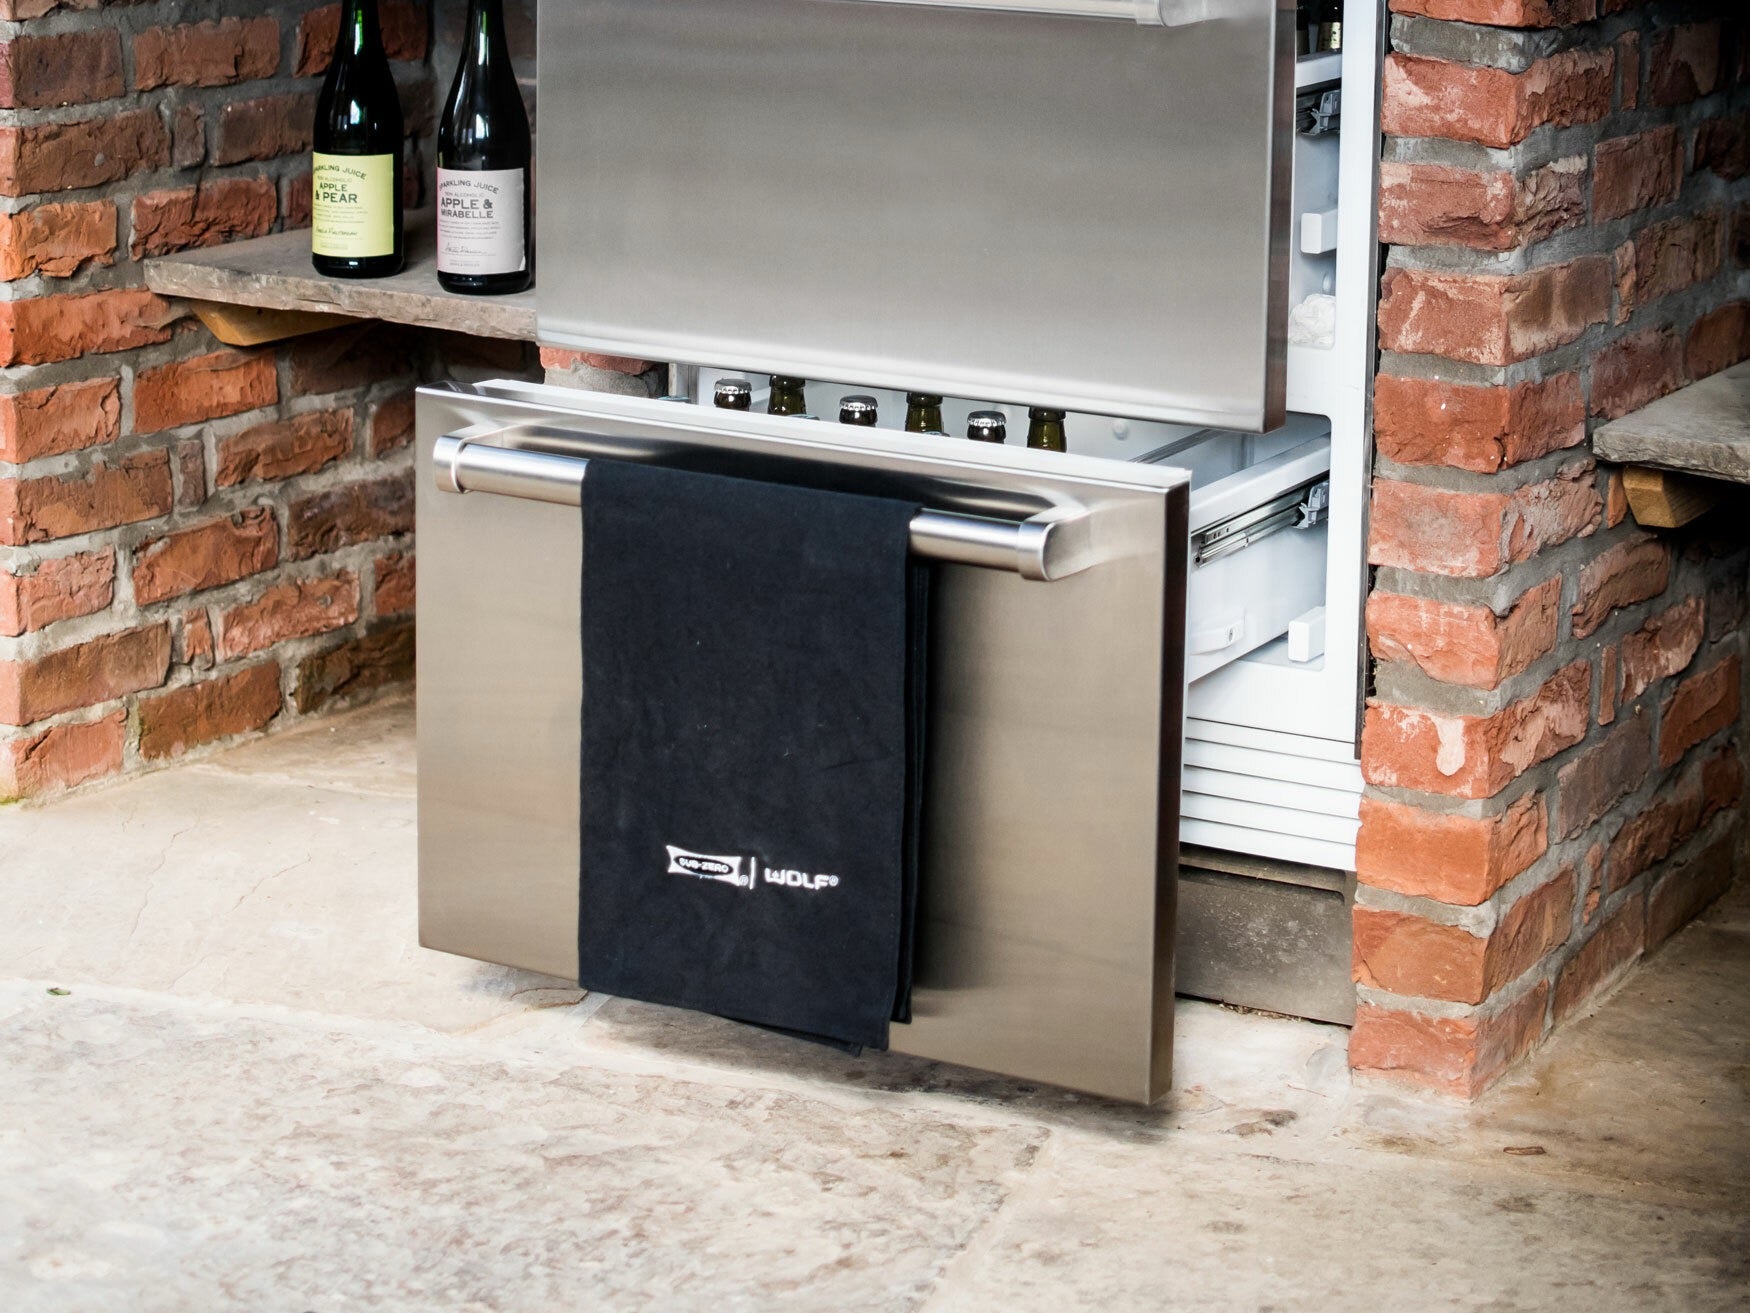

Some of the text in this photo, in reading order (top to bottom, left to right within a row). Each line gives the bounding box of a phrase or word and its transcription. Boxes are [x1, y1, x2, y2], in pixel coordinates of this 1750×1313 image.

[342, 168, 367, 180] JUICE
[320, 182, 348, 192] APPLE
[474, 181, 499, 194] JUICE
[322, 192, 358, 203] PEAR
[441, 197, 493, 210] APPLE &
[441, 209, 494, 218] MIRABELLE
[679, 857, 729, 874] SUB-ZERO
